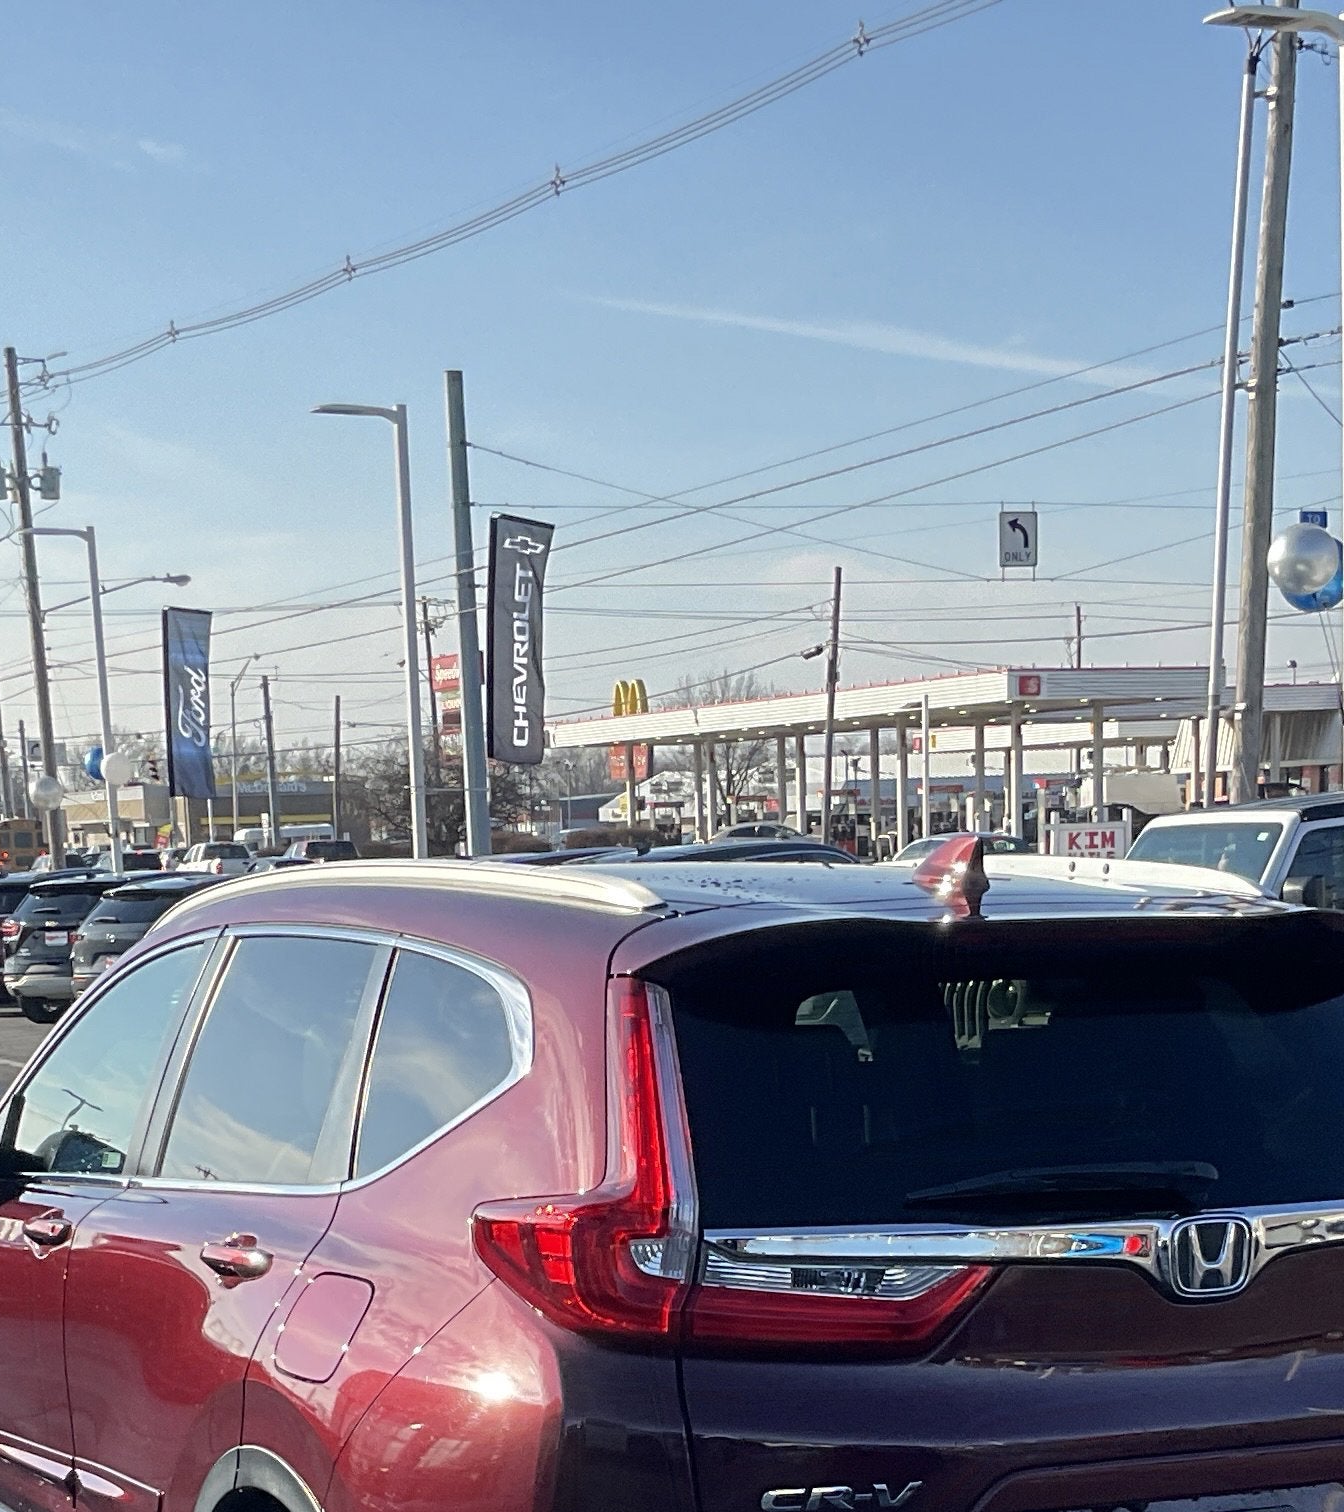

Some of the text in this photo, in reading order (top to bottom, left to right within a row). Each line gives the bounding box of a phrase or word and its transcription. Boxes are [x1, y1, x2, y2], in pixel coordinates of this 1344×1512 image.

[1004, 551, 1032, 562] ONLY
[512, 562, 533, 747] CHEVROLET
[178, 664, 207, 747] Ford
[1067, 830, 1116, 850] KIM
[760, 1480, 924, 1512] CR-V
